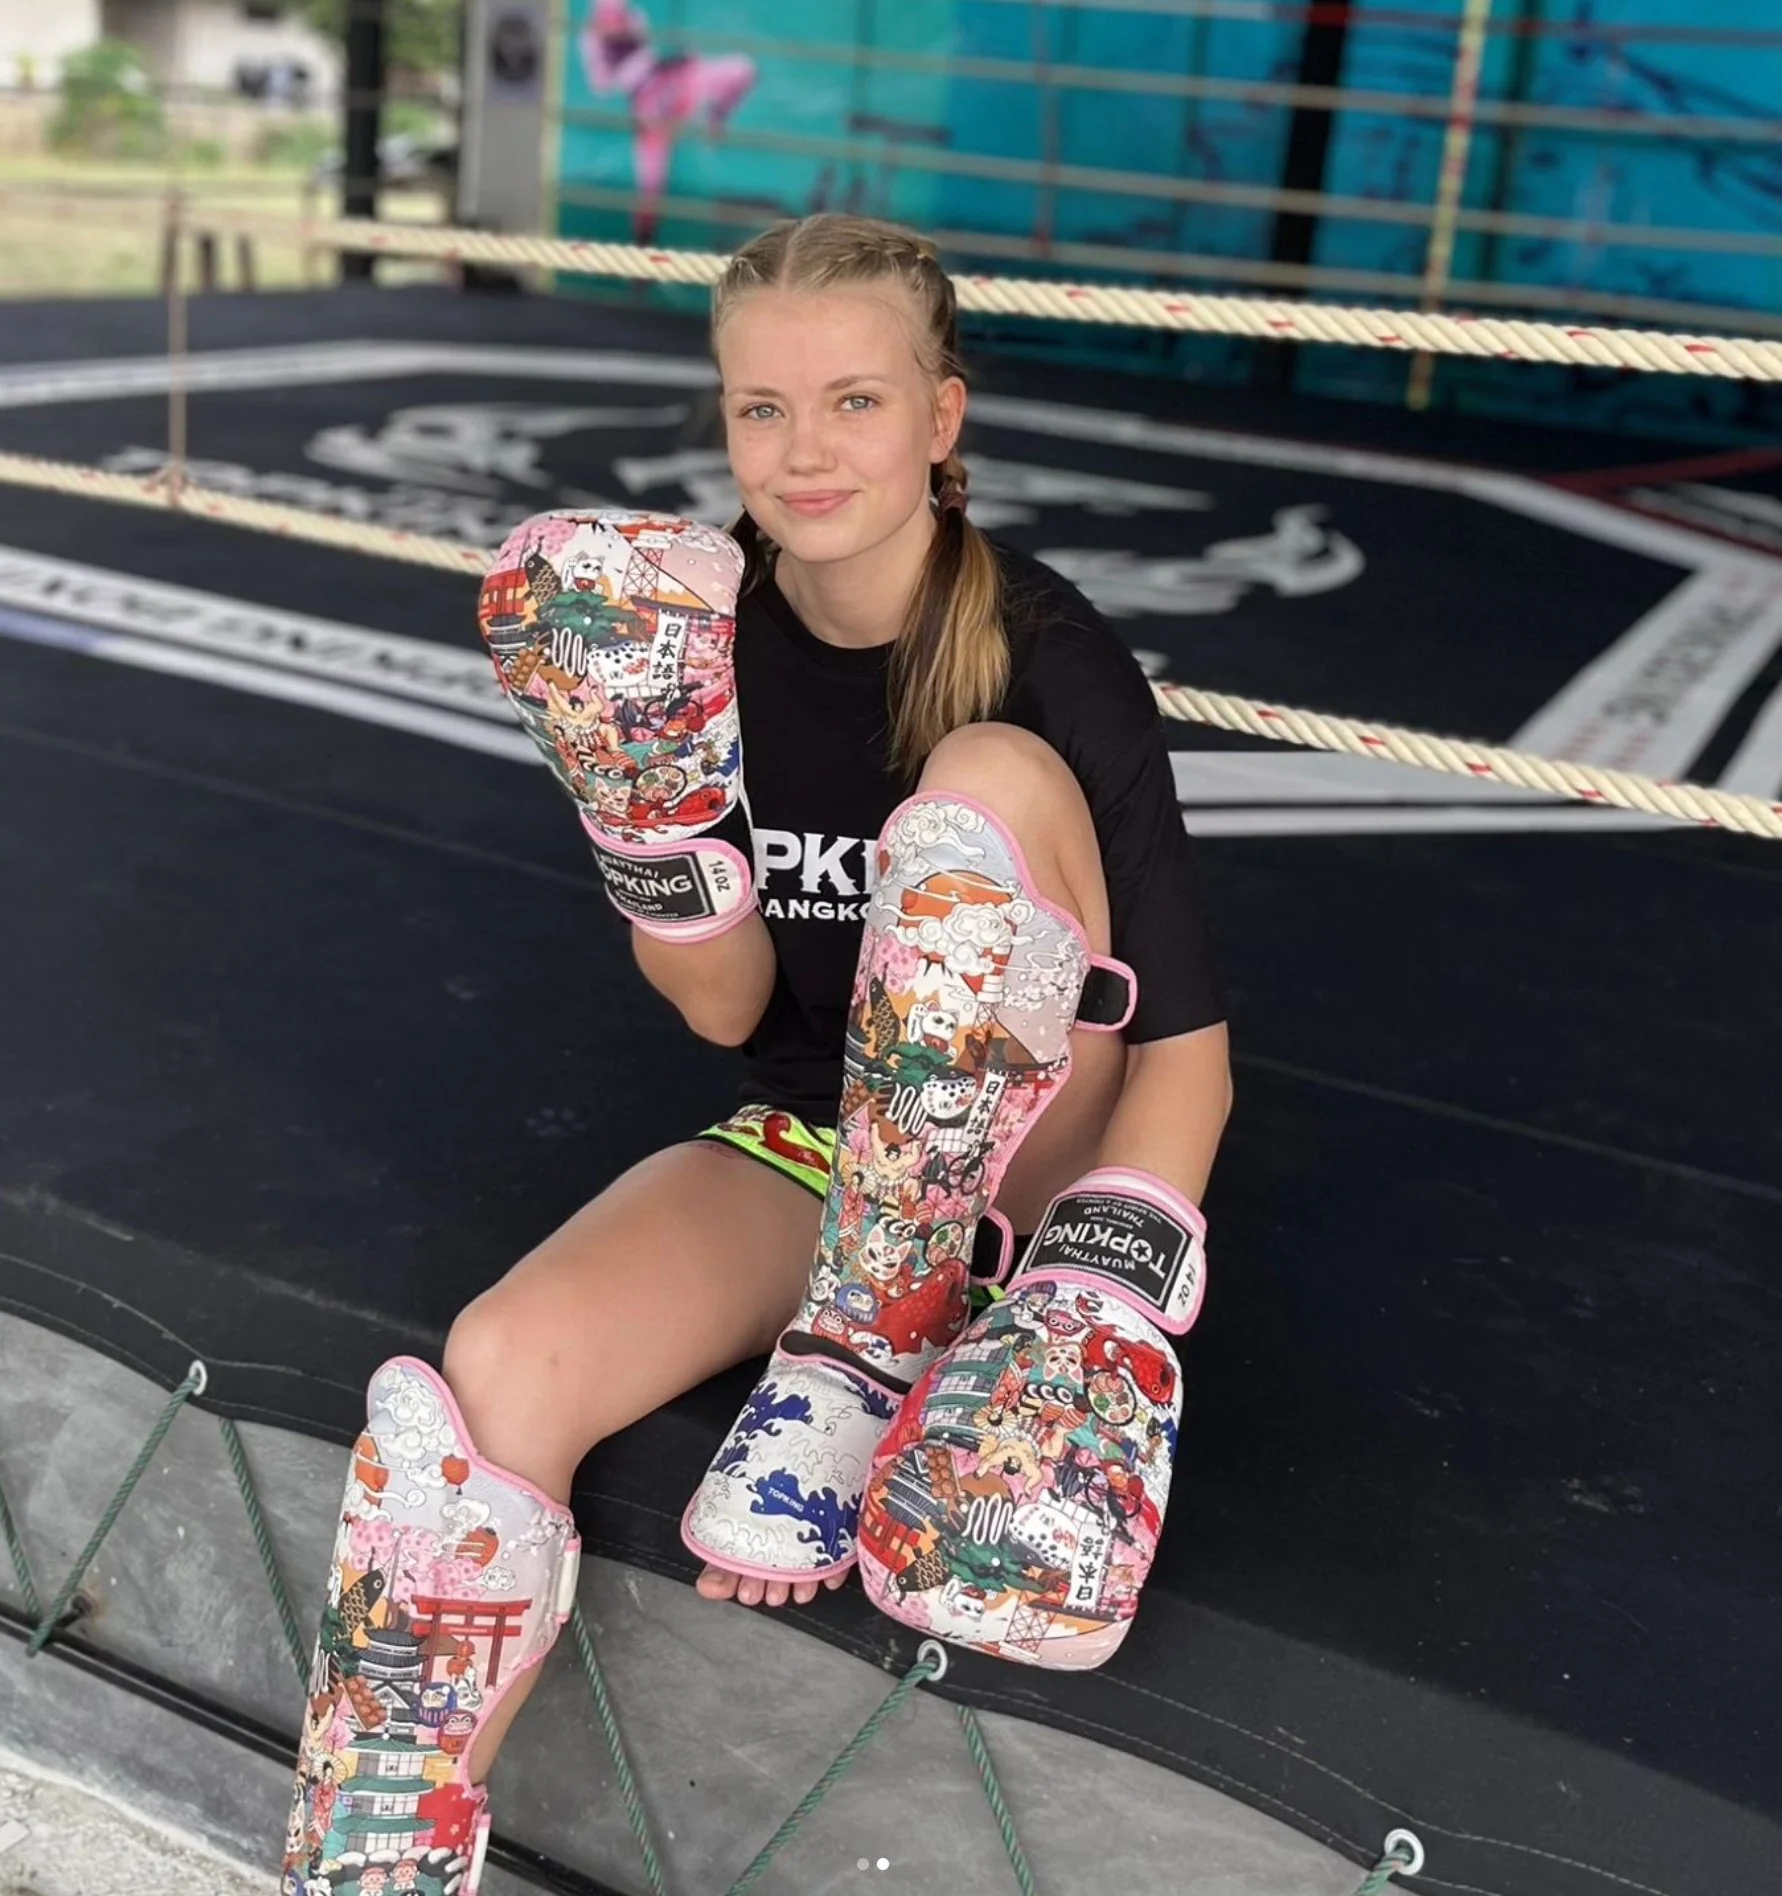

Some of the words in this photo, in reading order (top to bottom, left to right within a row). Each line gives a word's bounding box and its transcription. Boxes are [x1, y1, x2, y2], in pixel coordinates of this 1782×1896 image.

[652, 623, 682, 680] 日本語
[1083, 1206, 1145, 1228] THAILAND
[1043, 1223, 1166, 1279] TOPKING
[1058, 1244, 1136, 1270] MUAYTHAI
[1076, 1536, 1104, 1600] 日本語
